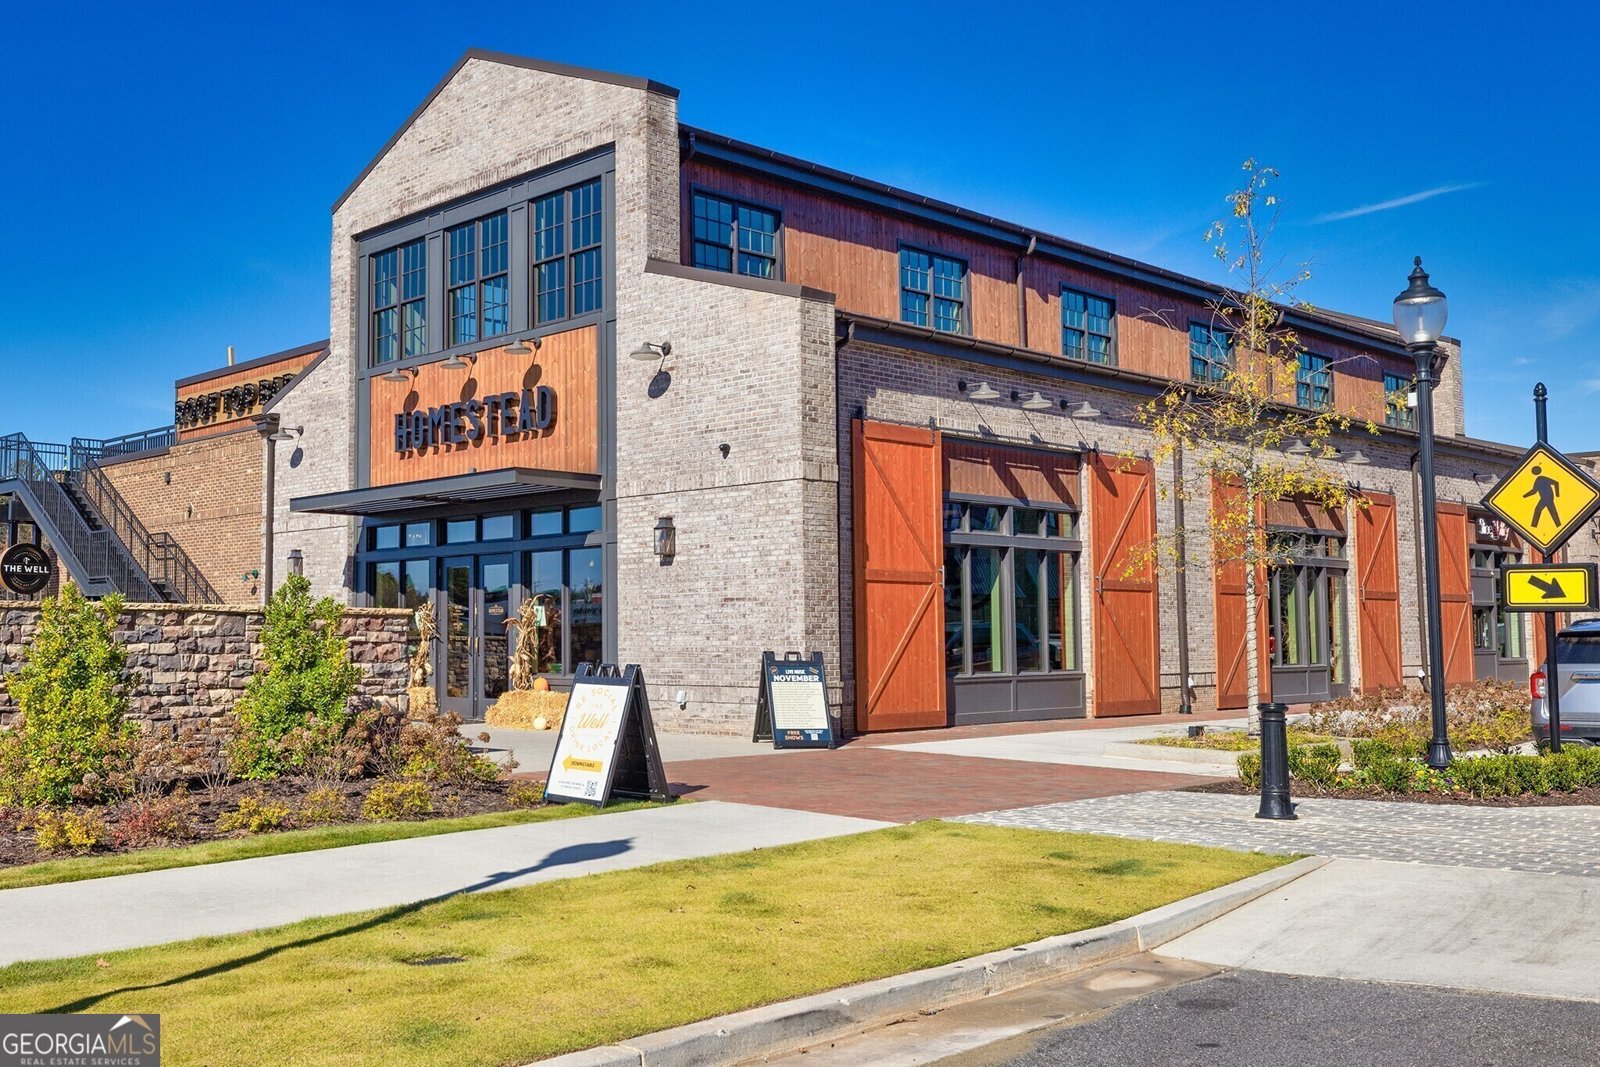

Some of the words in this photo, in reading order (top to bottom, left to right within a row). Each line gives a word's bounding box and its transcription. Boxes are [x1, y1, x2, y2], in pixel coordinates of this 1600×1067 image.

[395, 385, 556, 453] HOMESTEAD
[24, 565, 49, 574] WELL
[577, 712, 609, 729] Well
